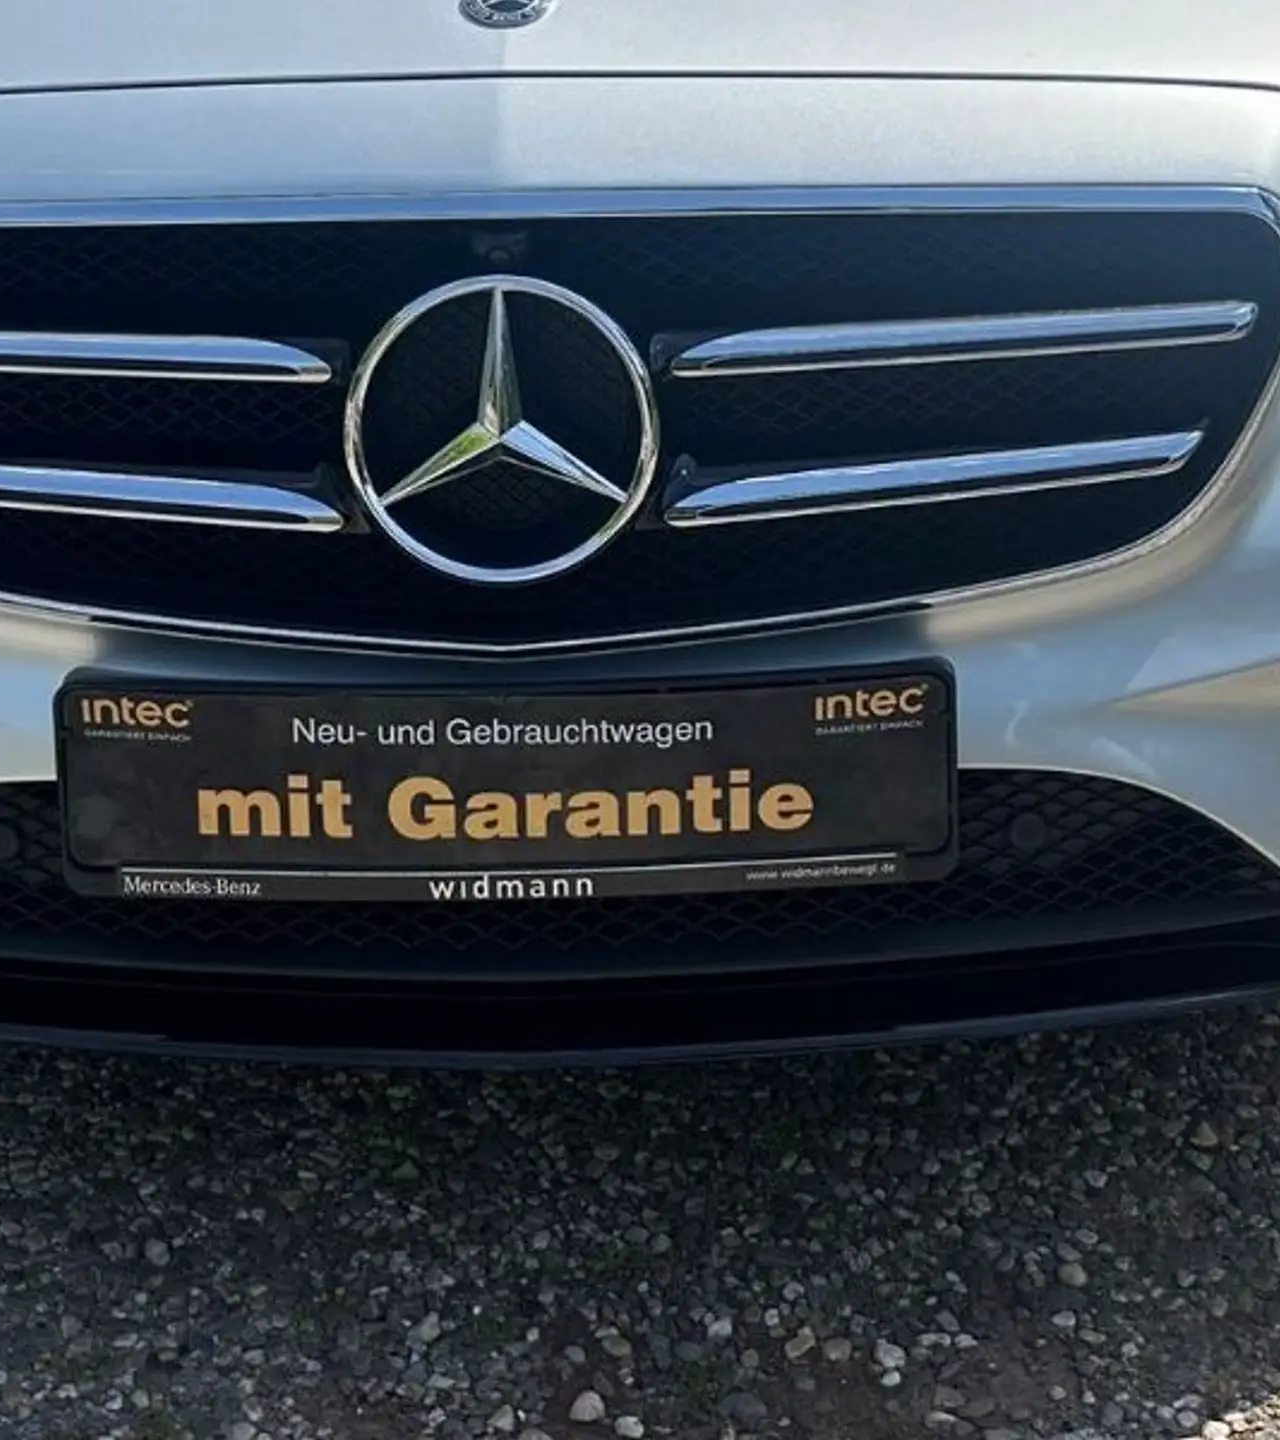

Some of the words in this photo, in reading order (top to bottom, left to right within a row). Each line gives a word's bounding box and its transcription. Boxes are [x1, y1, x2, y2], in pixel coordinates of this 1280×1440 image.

[292, 716, 368, 745] Neu-
[377, 719, 436, 746] und
[445, 717, 714, 748] Gebrauchtwagen
[197, 773, 355, 839] mit
[387, 768, 815, 841] Garantie
[123, 875, 263, 897] Mercedes-Benz
[428, 873, 595, 901] widmann
